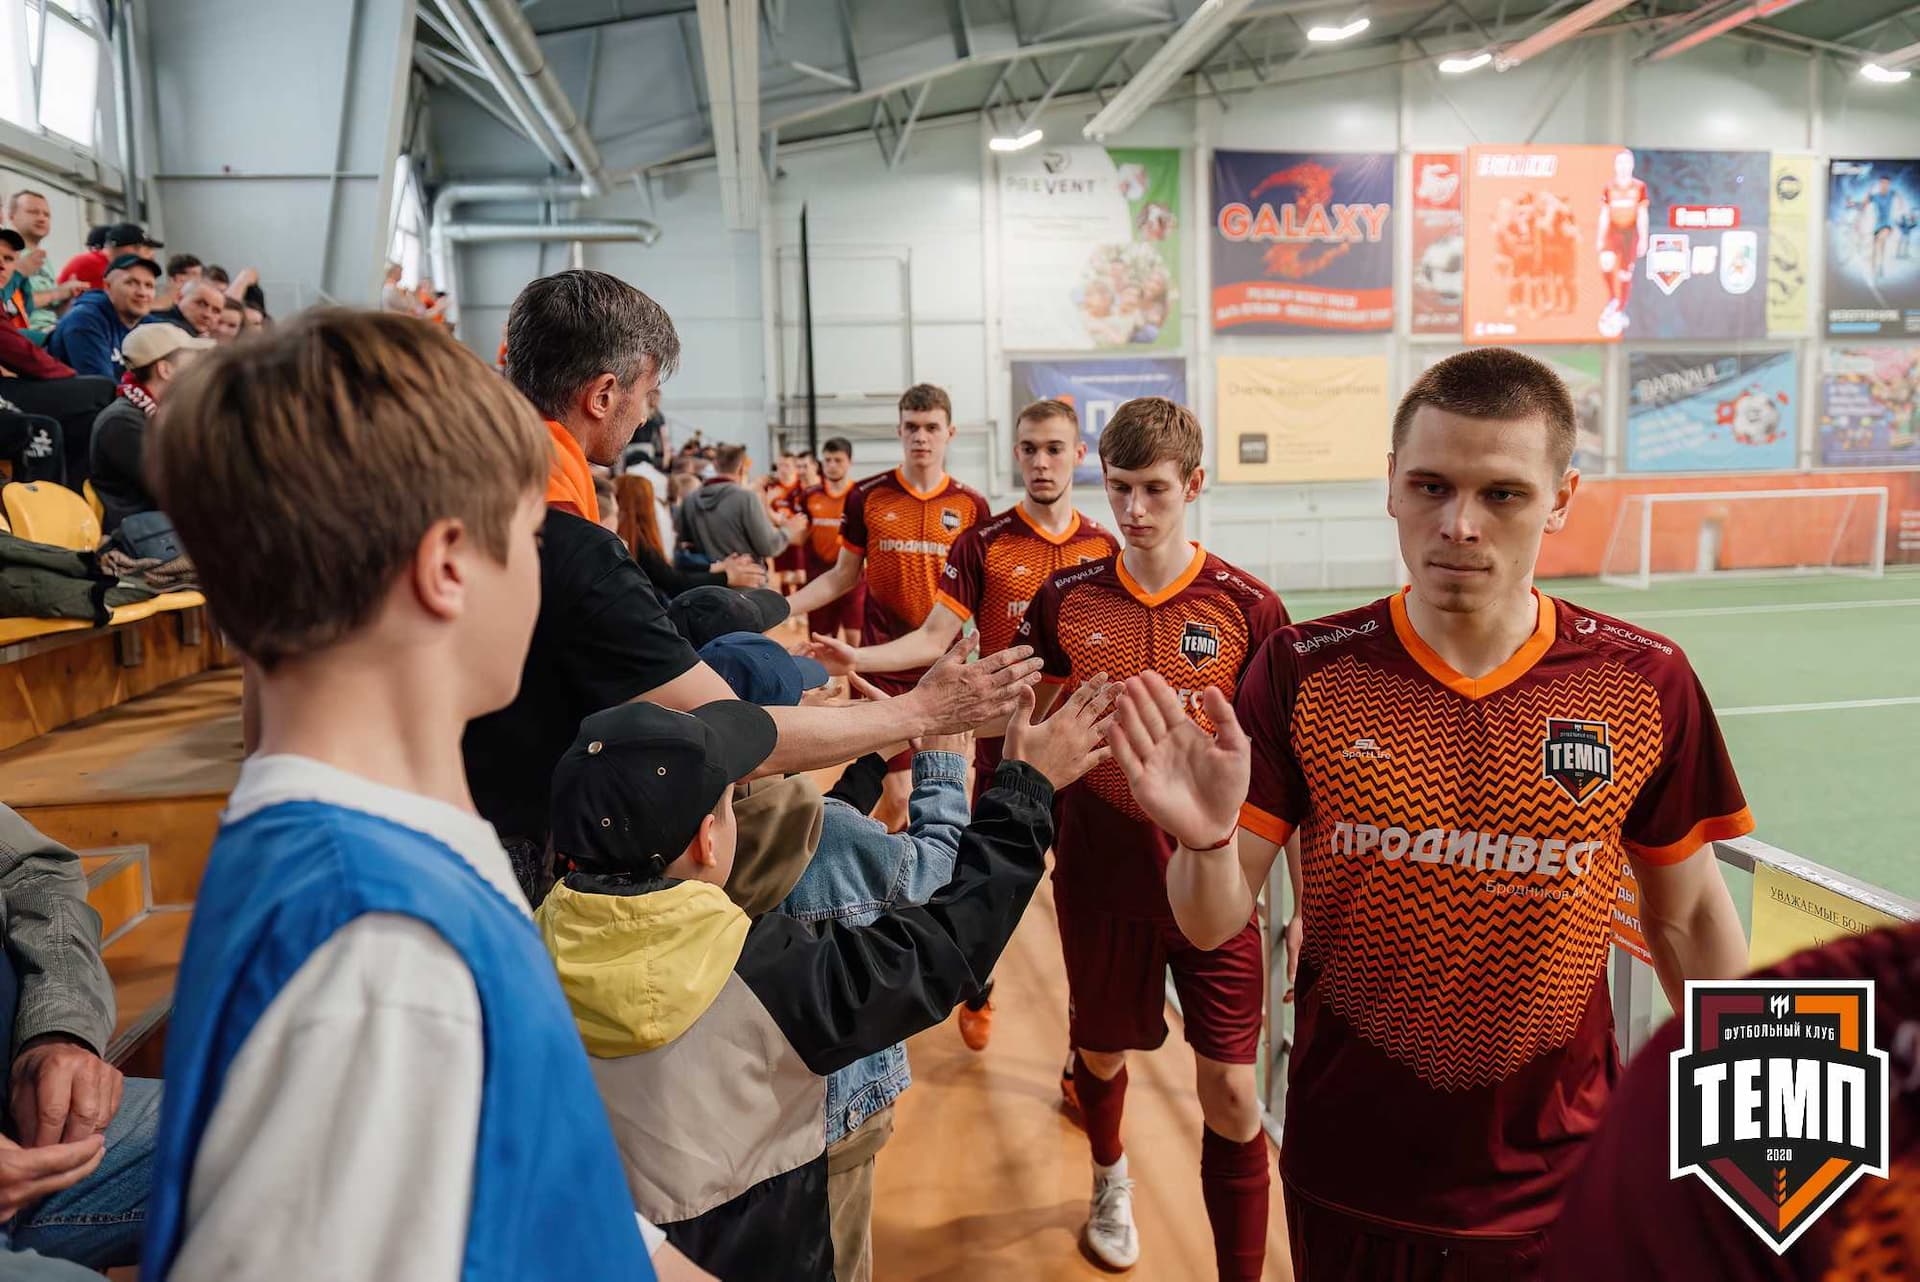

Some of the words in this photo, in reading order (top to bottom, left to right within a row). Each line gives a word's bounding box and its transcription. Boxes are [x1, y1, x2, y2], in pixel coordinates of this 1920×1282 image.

[1218, 203, 1391, 243] GALAXY
[1184, 636, 1216, 656] ТЕМП
[1601, 624, 1673, 655] ЭКСКЛЮЗИВ
[1550, 742, 1608, 776] ТЕМП
[1331, 821, 1605, 877] ПРОДИНВЕСТ
[1770, 886, 1840, 921] УВАЖАЕМЫЕ
